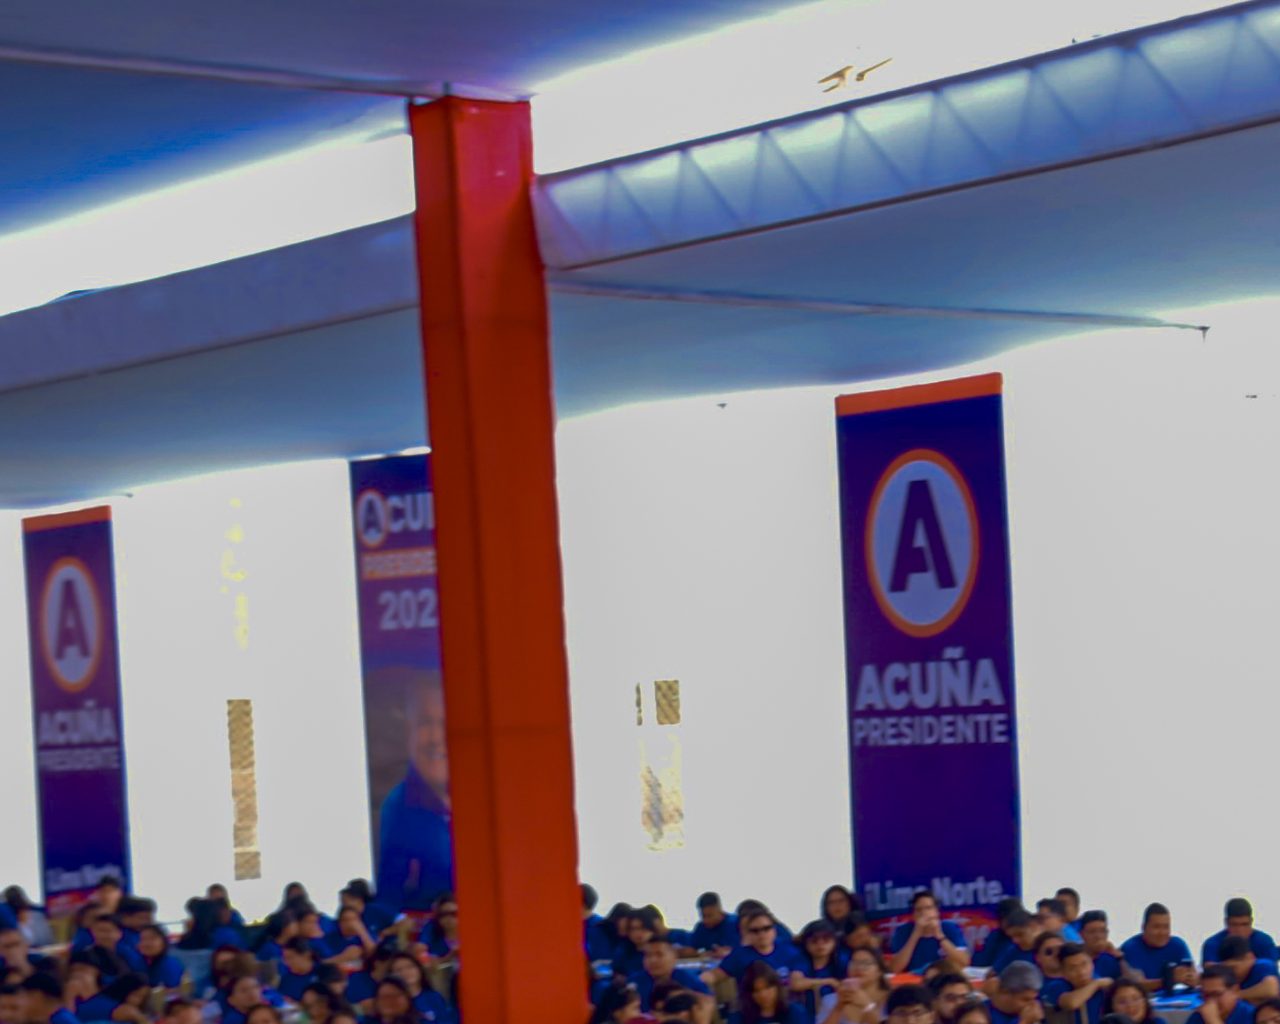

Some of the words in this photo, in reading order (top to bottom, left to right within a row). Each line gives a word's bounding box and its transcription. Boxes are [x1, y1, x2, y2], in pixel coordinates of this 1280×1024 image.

[360, 491, 433, 540] ACU
[889, 479, 957, 592] A
[379, 588, 438, 630] 202
[855, 646, 1005, 711] ACUÑA
[853, 713, 1009, 746] PRESIDENTE
